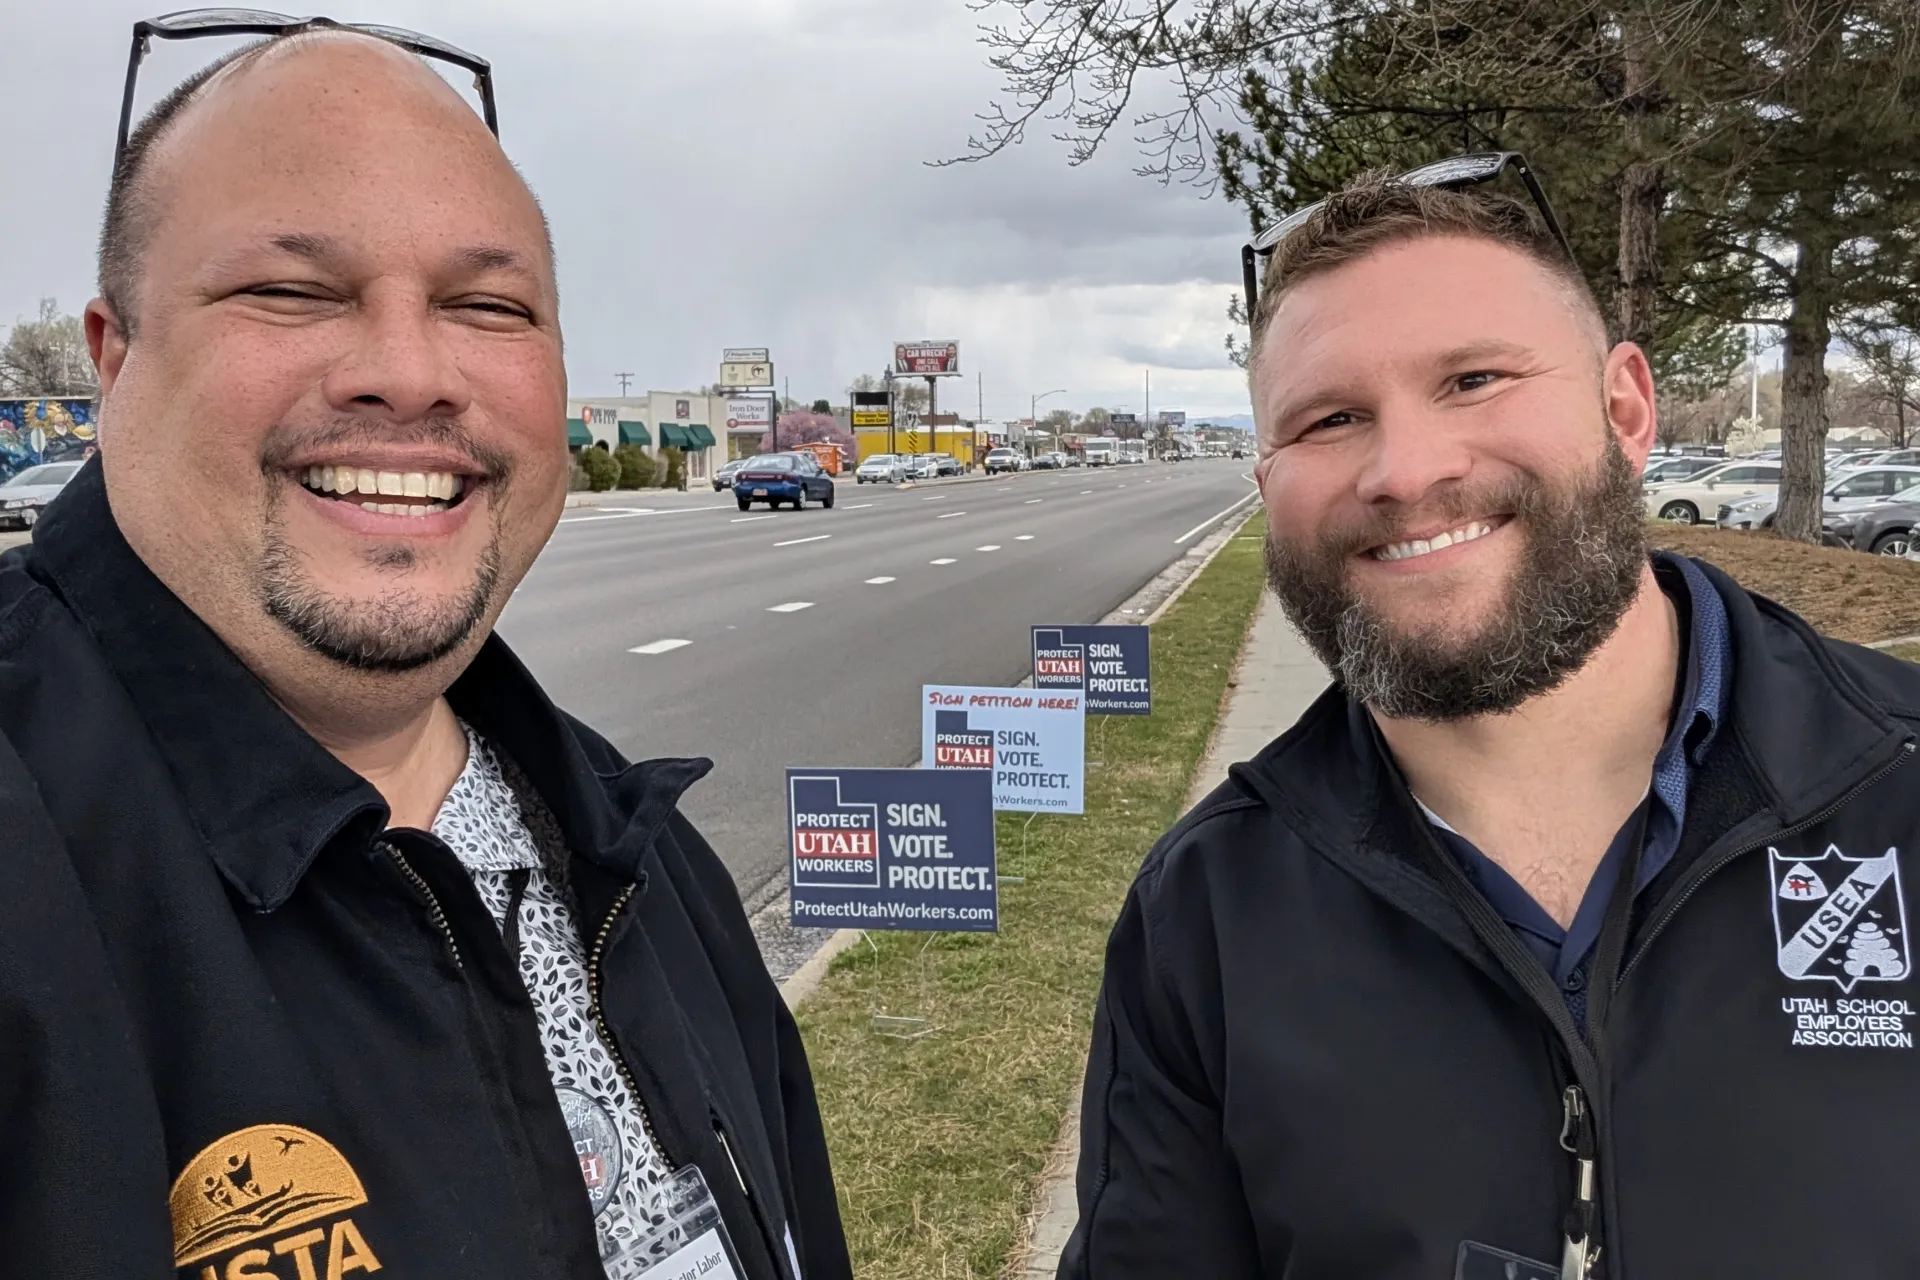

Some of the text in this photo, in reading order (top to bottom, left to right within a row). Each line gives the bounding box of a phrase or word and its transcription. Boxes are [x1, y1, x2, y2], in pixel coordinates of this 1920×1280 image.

[906, 349, 920, 358] CAR
[729, 404, 766, 412] Iron Door
[736, 412, 760, 420] Works
[1037, 649, 1080, 659] PROTECT
[1088, 643, 1123, 658] SIGN.
[1038, 660, 1081, 674] UTAH
[1089, 661, 1127, 675] VOTE.
[1038, 675, 1082, 684] WORKERS
[1089, 678, 1149, 693] PROTECT.
[969, 694, 1033, 708] PETITION
[1038, 696, 1079, 711] HERE!
[937, 733, 991, 745] PROTECT
[997, 730, 1040, 747] SIGN.
[937, 747, 991, 764] UTAH
[998, 751, 1044, 768] VOTE.
[996, 772, 1071, 790] PROTECT.
[796, 813, 870, 828] PROTECT
[887, 803, 947, 828] SIGN.
[797, 832, 872, 854] UTAH
[888, 834, 953, 859] VOTE.
[797, 858, 873, 873] WORKERS
[888, 866, 992, 891] PROTECT.
[794, 900, 993, 921] ProtectUtahWorkers.com
[1800, 878, 1877, 949] USEA
[1781, 997, 1916, 1015] UTAH SCHOOL
[1797, 1014, 1904, 1031] EMPLOYEES
[1791, 1030, 1914, 1048] ASSOCIATION
[200, 1218, 383, 1280] STA
[695, 1251, 722, 1276] Labor
